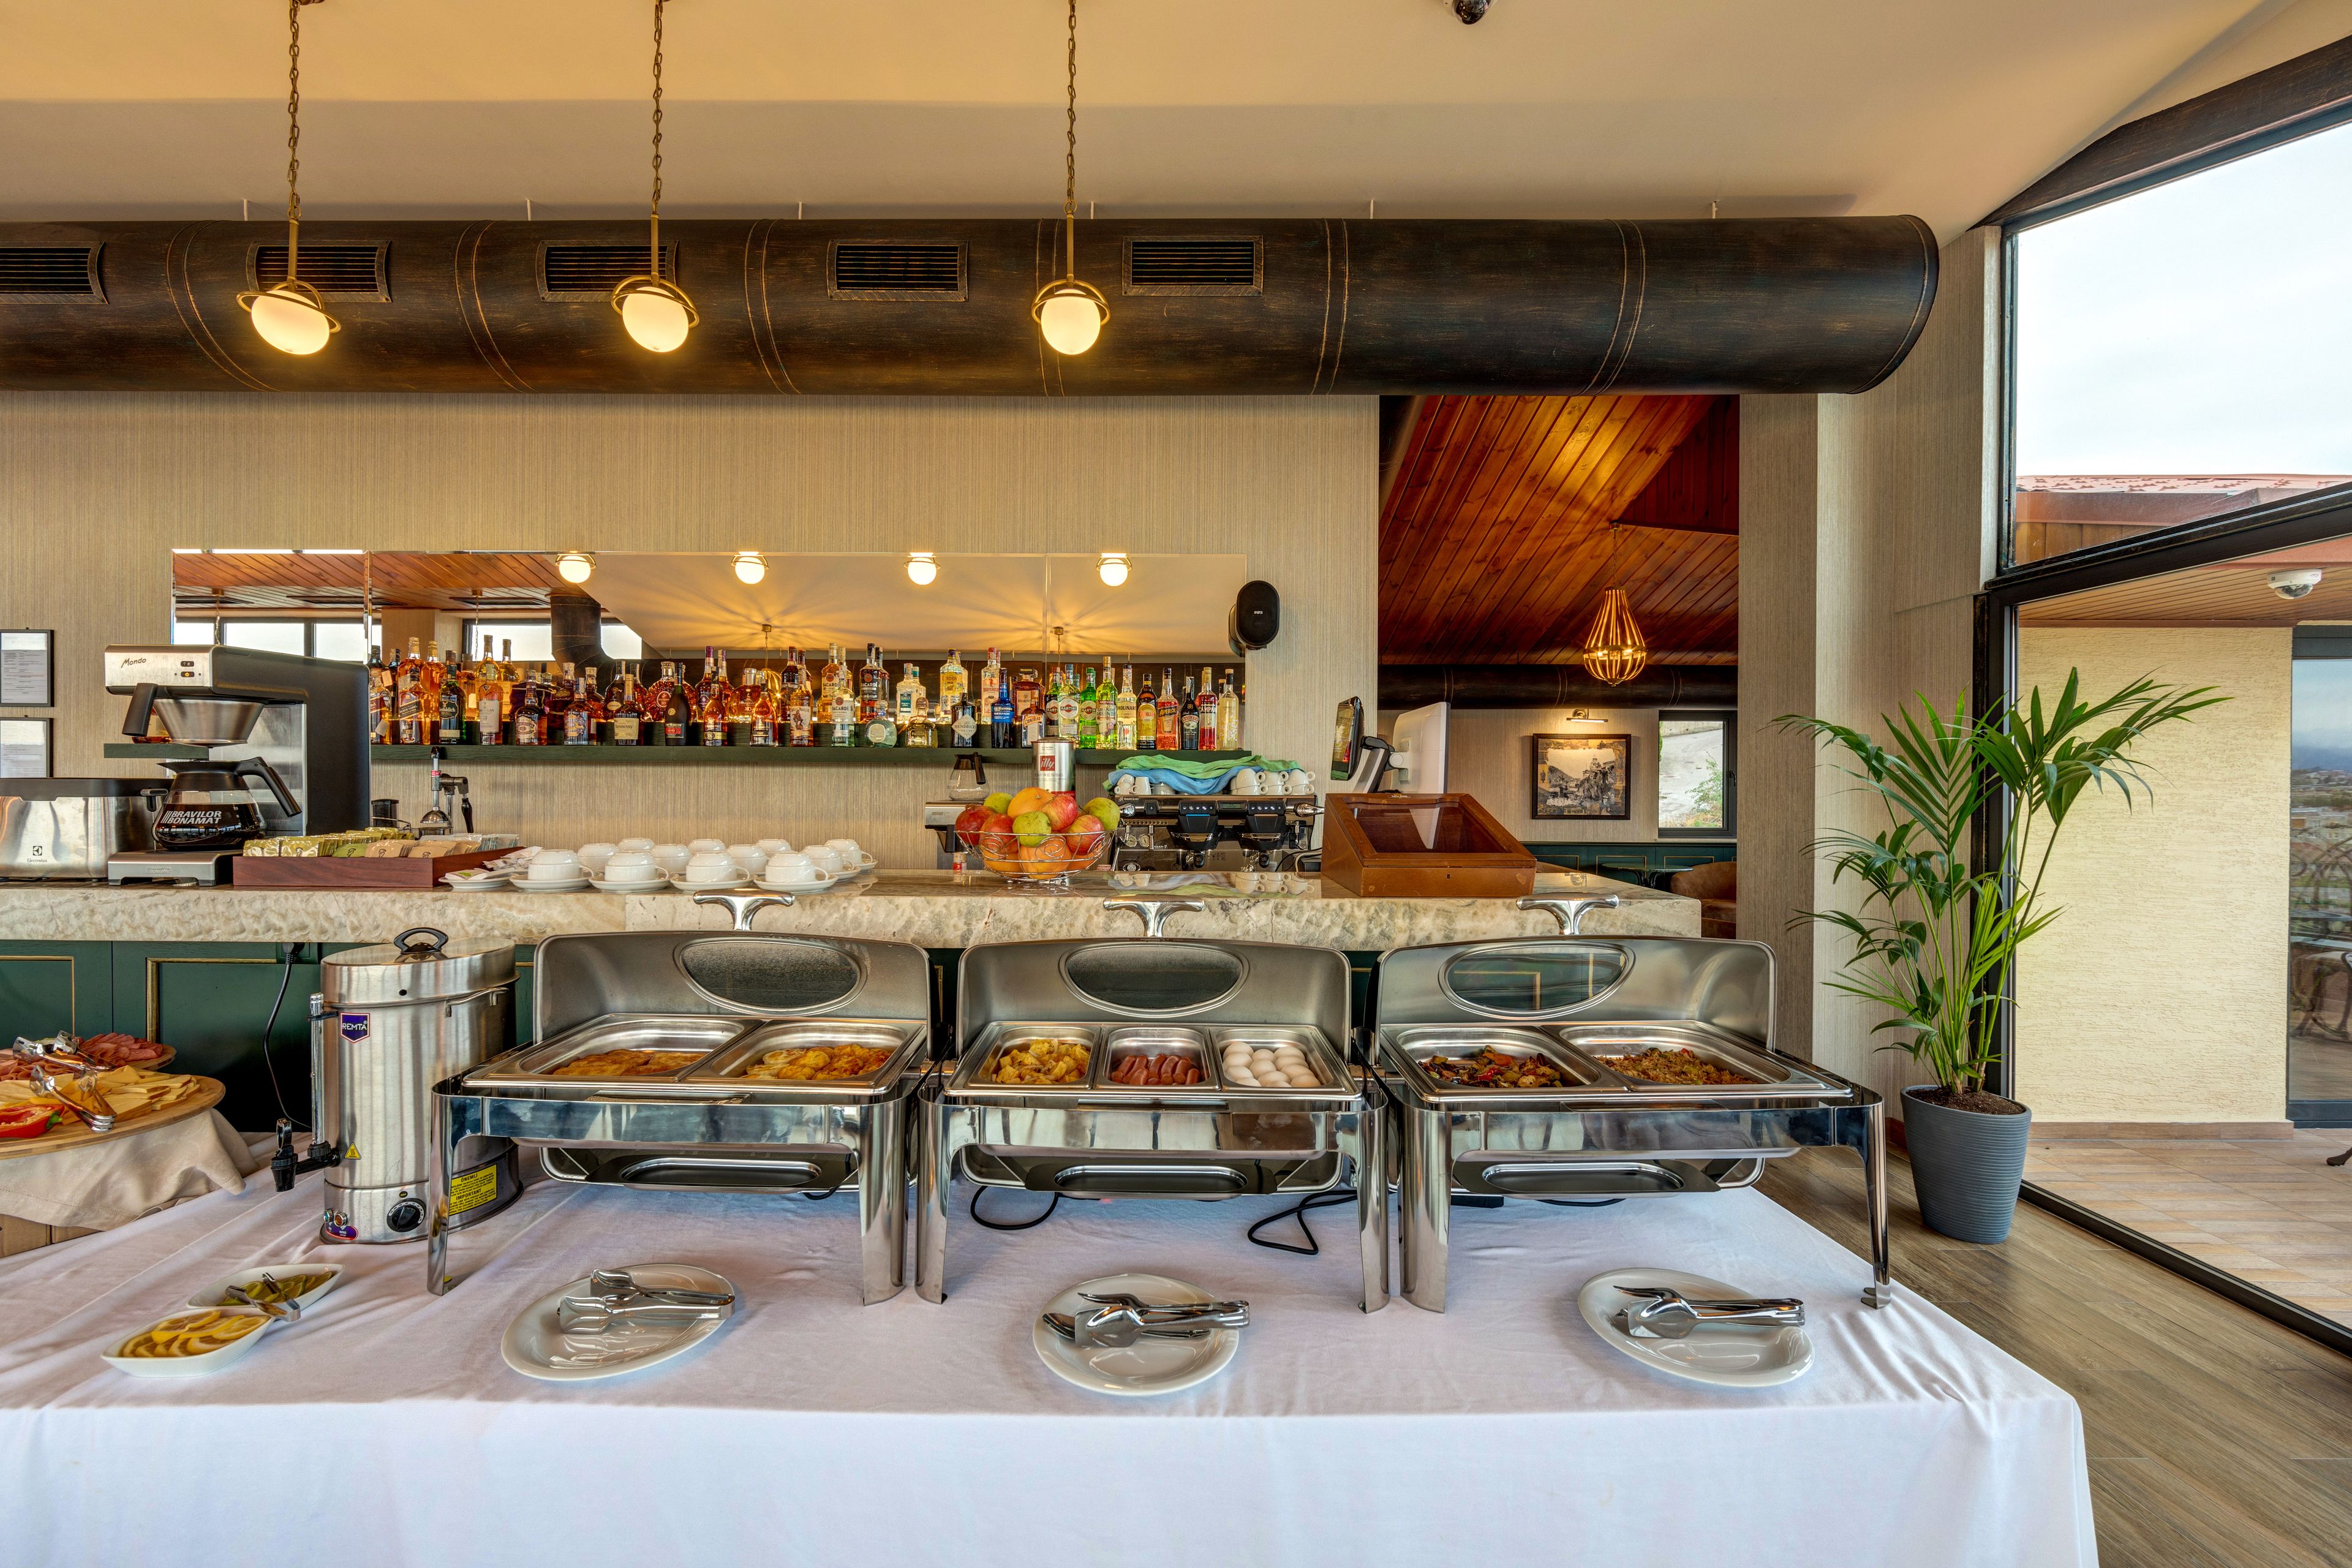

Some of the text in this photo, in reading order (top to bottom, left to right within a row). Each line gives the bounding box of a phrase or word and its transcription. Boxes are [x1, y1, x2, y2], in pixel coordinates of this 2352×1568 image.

[121, 657, 146, 668] Mondo
[1041, 758, 1054, 770] illy
[456, 1188, 481, 1200] IMPORTANT
